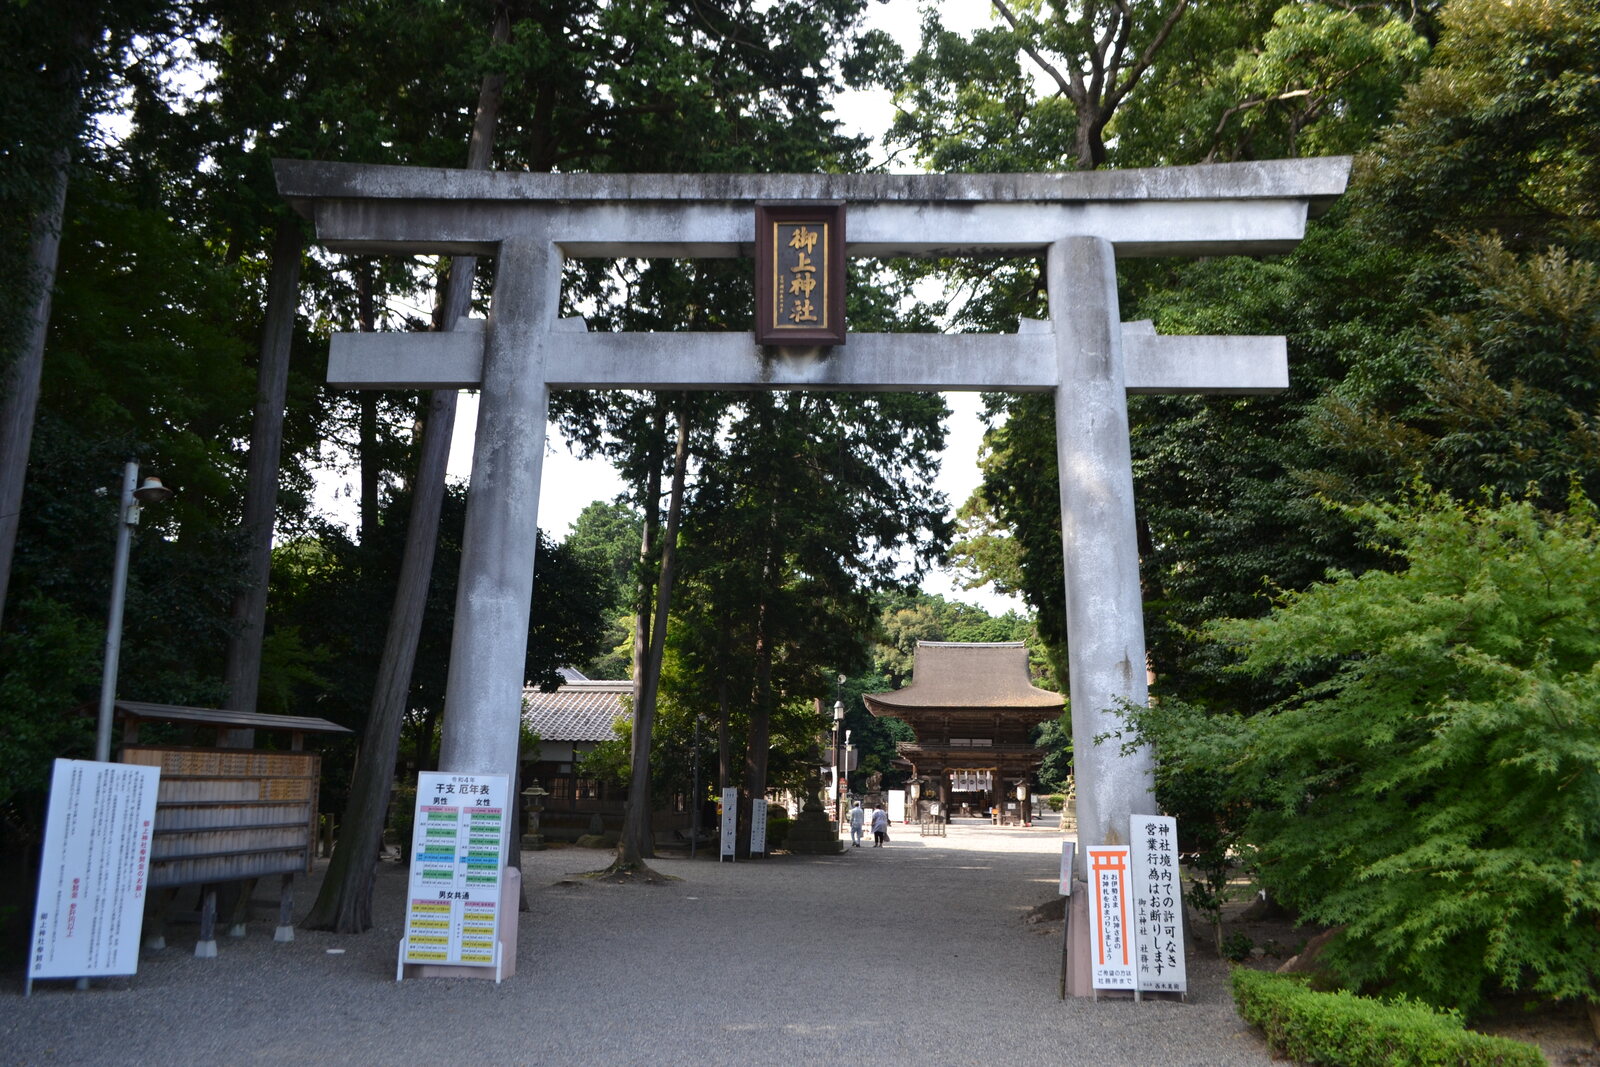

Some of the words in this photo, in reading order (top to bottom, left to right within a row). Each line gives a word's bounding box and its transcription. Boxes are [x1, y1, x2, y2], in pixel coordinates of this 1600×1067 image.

[788, 225, 818, 323] 御上神社
[432, 796, 448, 806] 男性
[435, 783, 456, 794] 干支
[458, 783, 490, 795] 厄年表
[475, 798, 491, 807] 女性
[438, 890, 470, 900] 男女共通
[1110, 873, 1119, 908] お伊勢さま
[1145, 823, 1165, 977] 営業行為はお断りします
[1158, 823, 1177, 968] 神社境内での許可なき
[1102, 874, 1112, 961] お神札をおまつりしましょう
[1112, 915, 1121, 949] 氏神さまの
[1138, 898, 1148, 936] 御上神社
[1097, 969, 1132, 977] ご希望の方は
[1140, 943, 1150, 974] 社務所
[1097, 977, 1132, 985] 社務所まで
